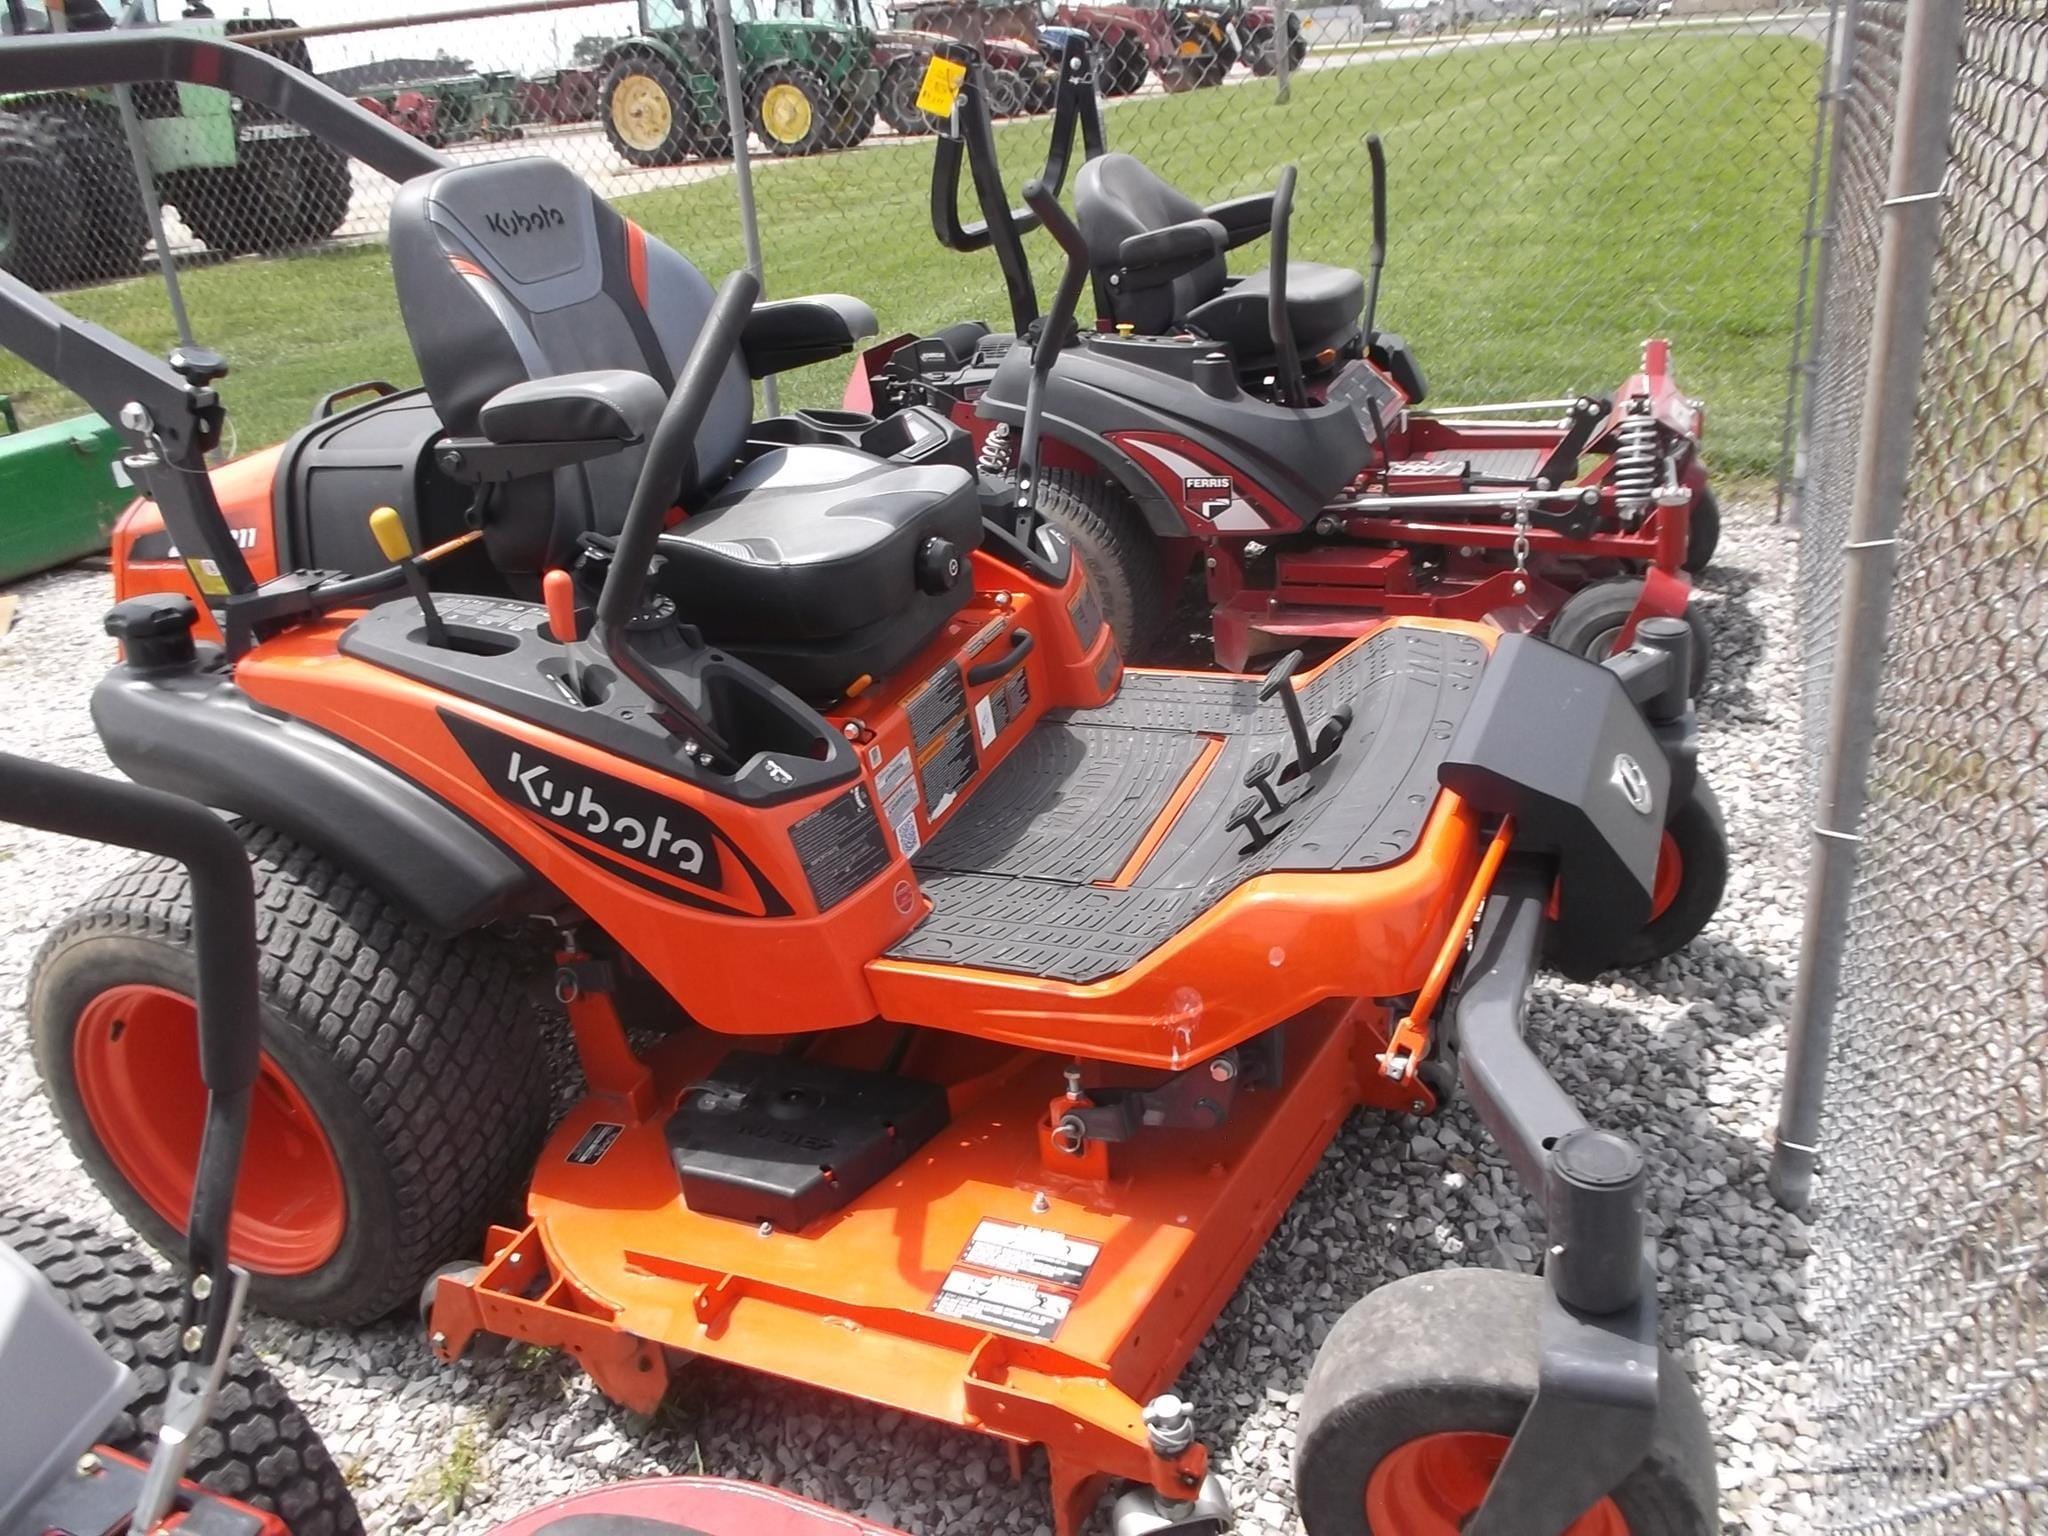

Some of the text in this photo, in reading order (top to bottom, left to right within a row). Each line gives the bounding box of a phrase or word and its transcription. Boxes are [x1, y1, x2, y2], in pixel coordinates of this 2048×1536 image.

[486, 203, 565, 237] Kubota
[1186, 478, 1230, 488] FERRIS
[507, 751, 705, 874] Kubota
